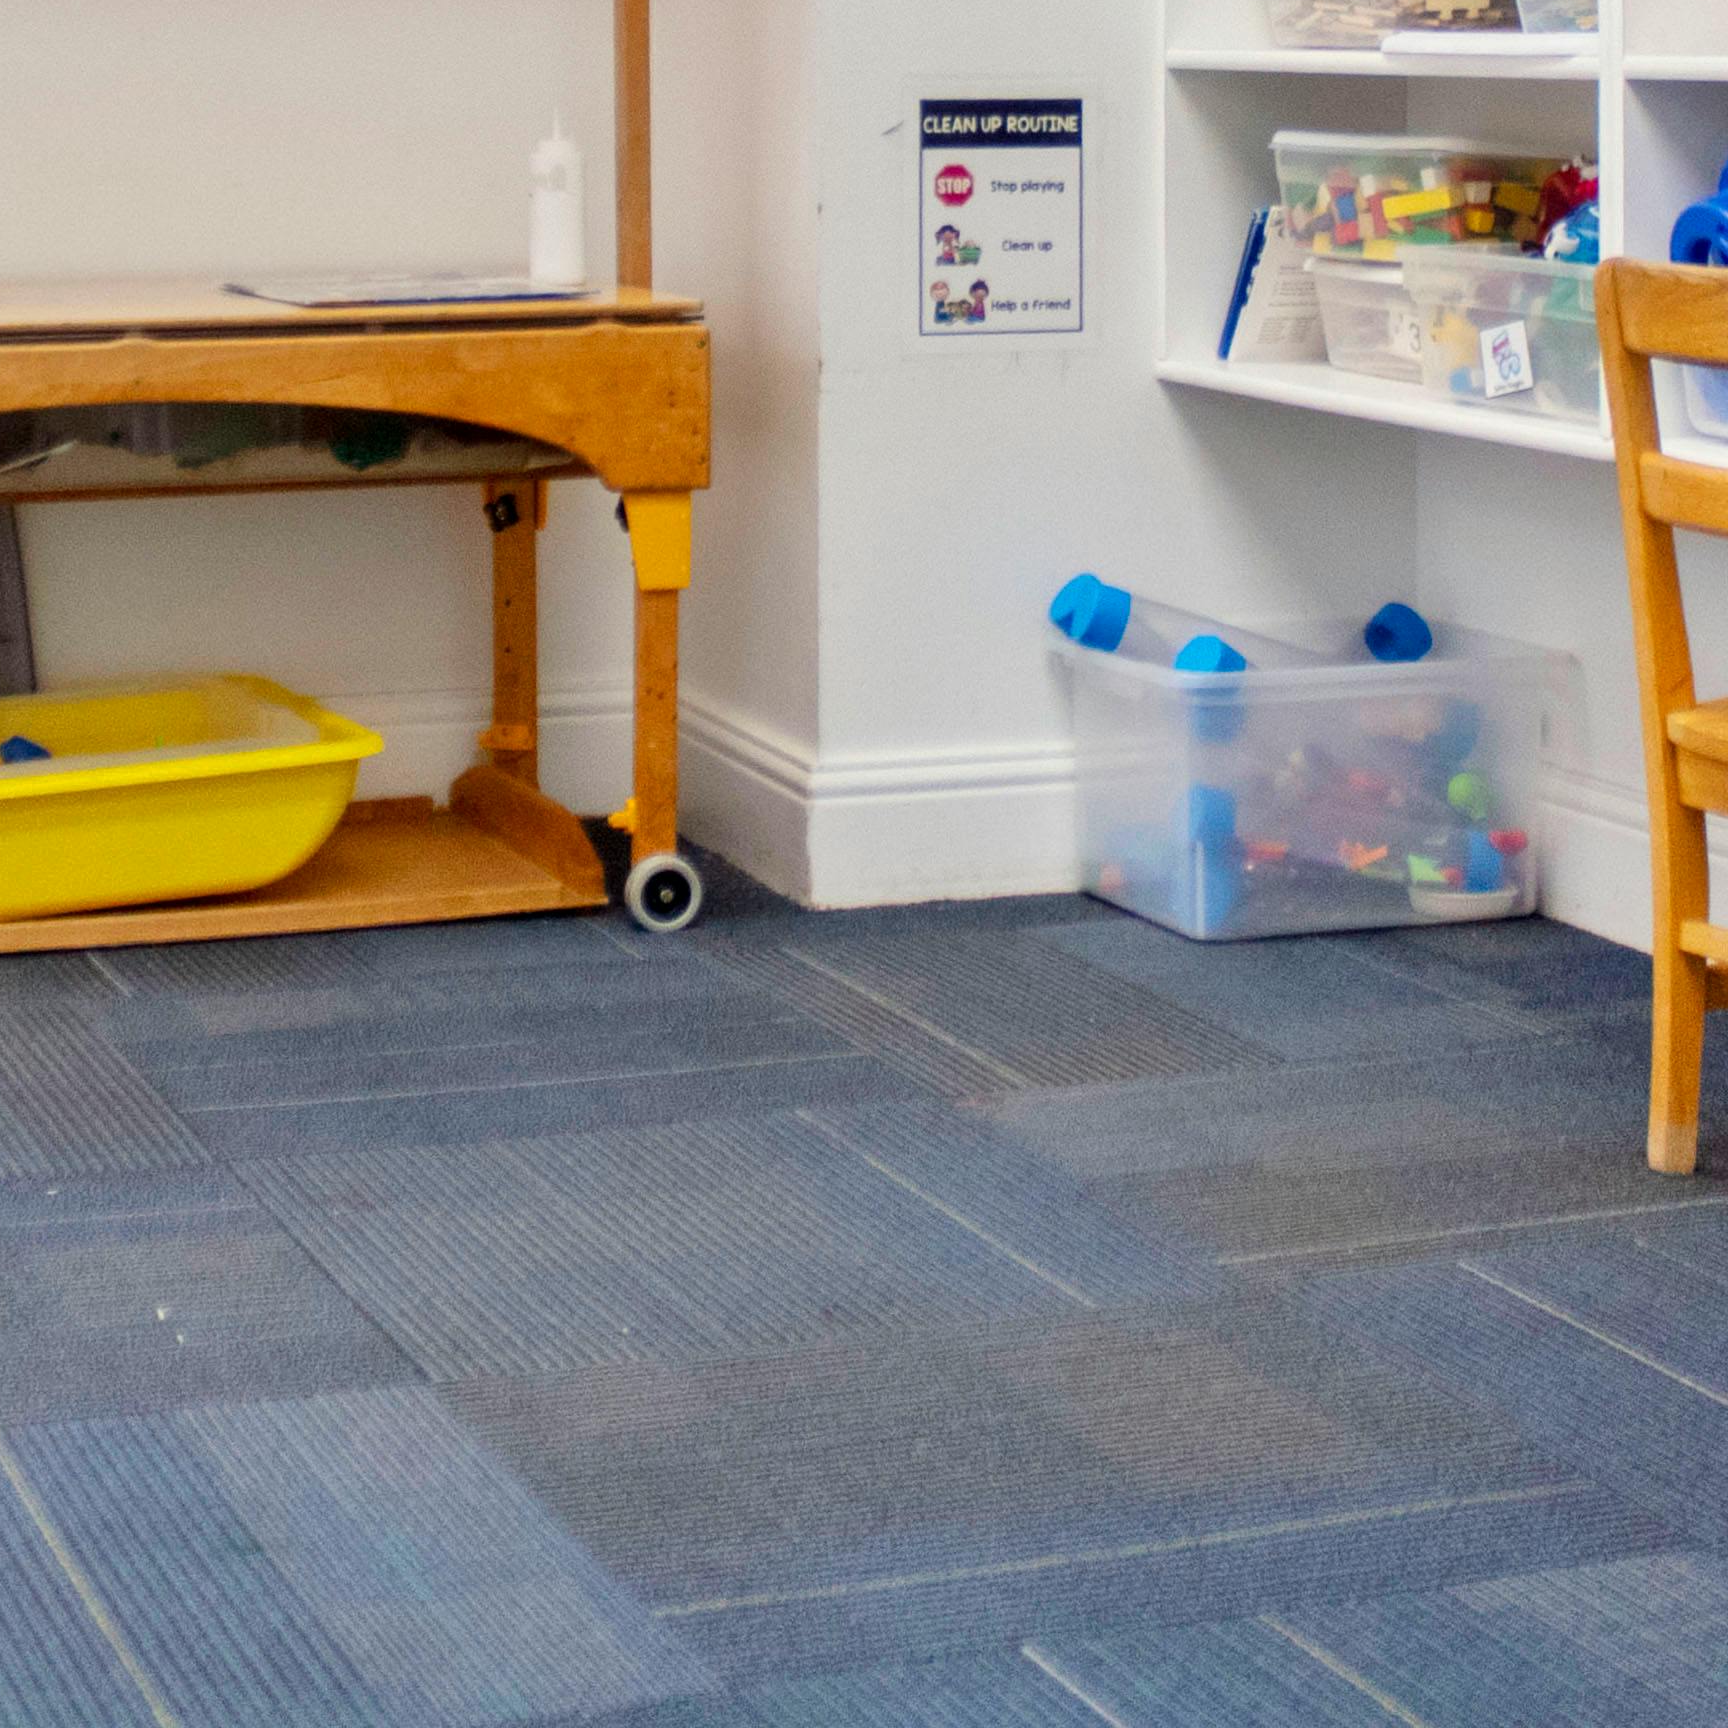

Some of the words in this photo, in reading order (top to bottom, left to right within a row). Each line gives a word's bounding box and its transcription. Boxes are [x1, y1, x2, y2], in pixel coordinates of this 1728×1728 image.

[922, 116, 977, 135] CLEAN
[981, 116, 1003, 134] UP
[1006, 115, 1079, 134] ROUTINE
[936, 178, 971, 195] STOP
[990, 180, 1017, 194] Stop
[1021, 179, 1065, 194] playing
[1001, 240, 1034, 252] Clean
[1038, 241, 1053, 254] up
[990, 299, 1016, 313] Help
[1021, 301, 1029, 311] a
[1032, 298, 1071, 312] friend
